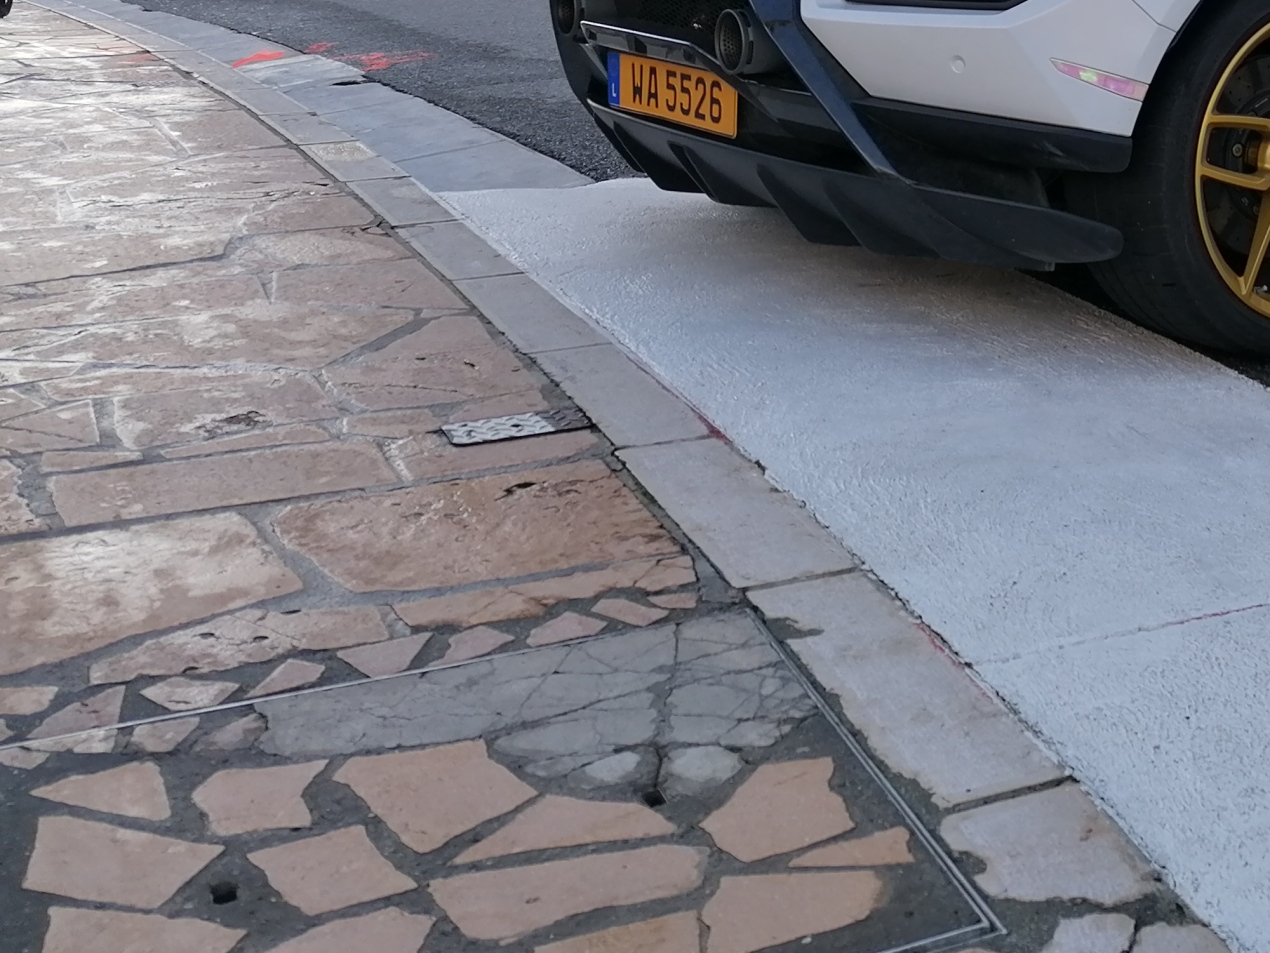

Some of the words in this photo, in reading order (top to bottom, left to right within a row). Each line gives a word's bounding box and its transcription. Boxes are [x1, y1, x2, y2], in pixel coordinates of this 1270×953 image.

[611, 82, 617, 97] L
[631, 62, 659, 108] WA
[665, 69, 723, 124] 5526
